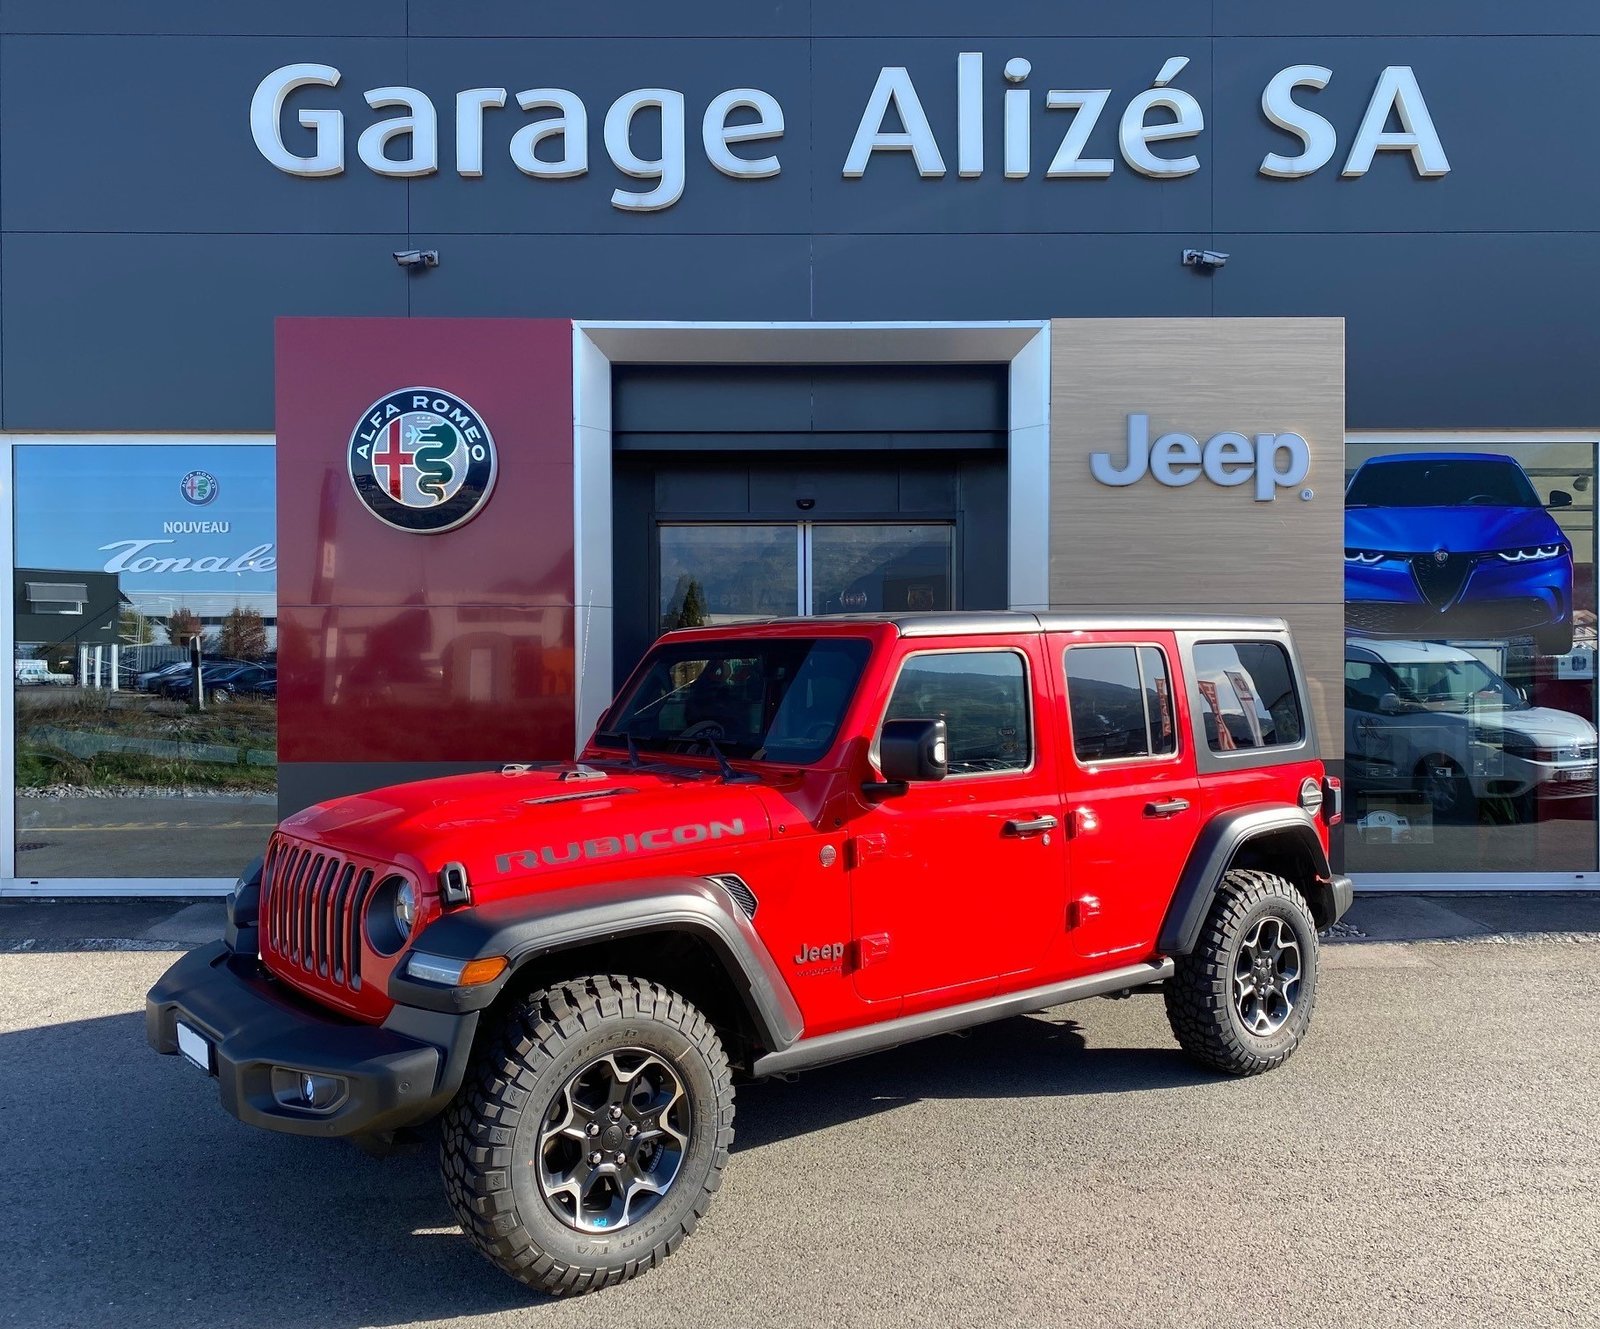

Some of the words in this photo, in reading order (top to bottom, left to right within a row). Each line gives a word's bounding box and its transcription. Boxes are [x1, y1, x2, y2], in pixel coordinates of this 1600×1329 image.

[250, 63, 785, 212] Garage
[842, 52, 1204, 178] Alizé
[1259, 64, 1451, 178] SA
[356, 403, 401, 460] ALFA
[412, 395, 486, 462] ROMEO
[1089, 414, 1311, 502] Jeep
[163, 521, 230, 534] NOUVEAU
[98, 539, 278, 573] Tonale
[495, 818, 745, 874] RUBICON
[795, 942, 845, 964] Jeep
